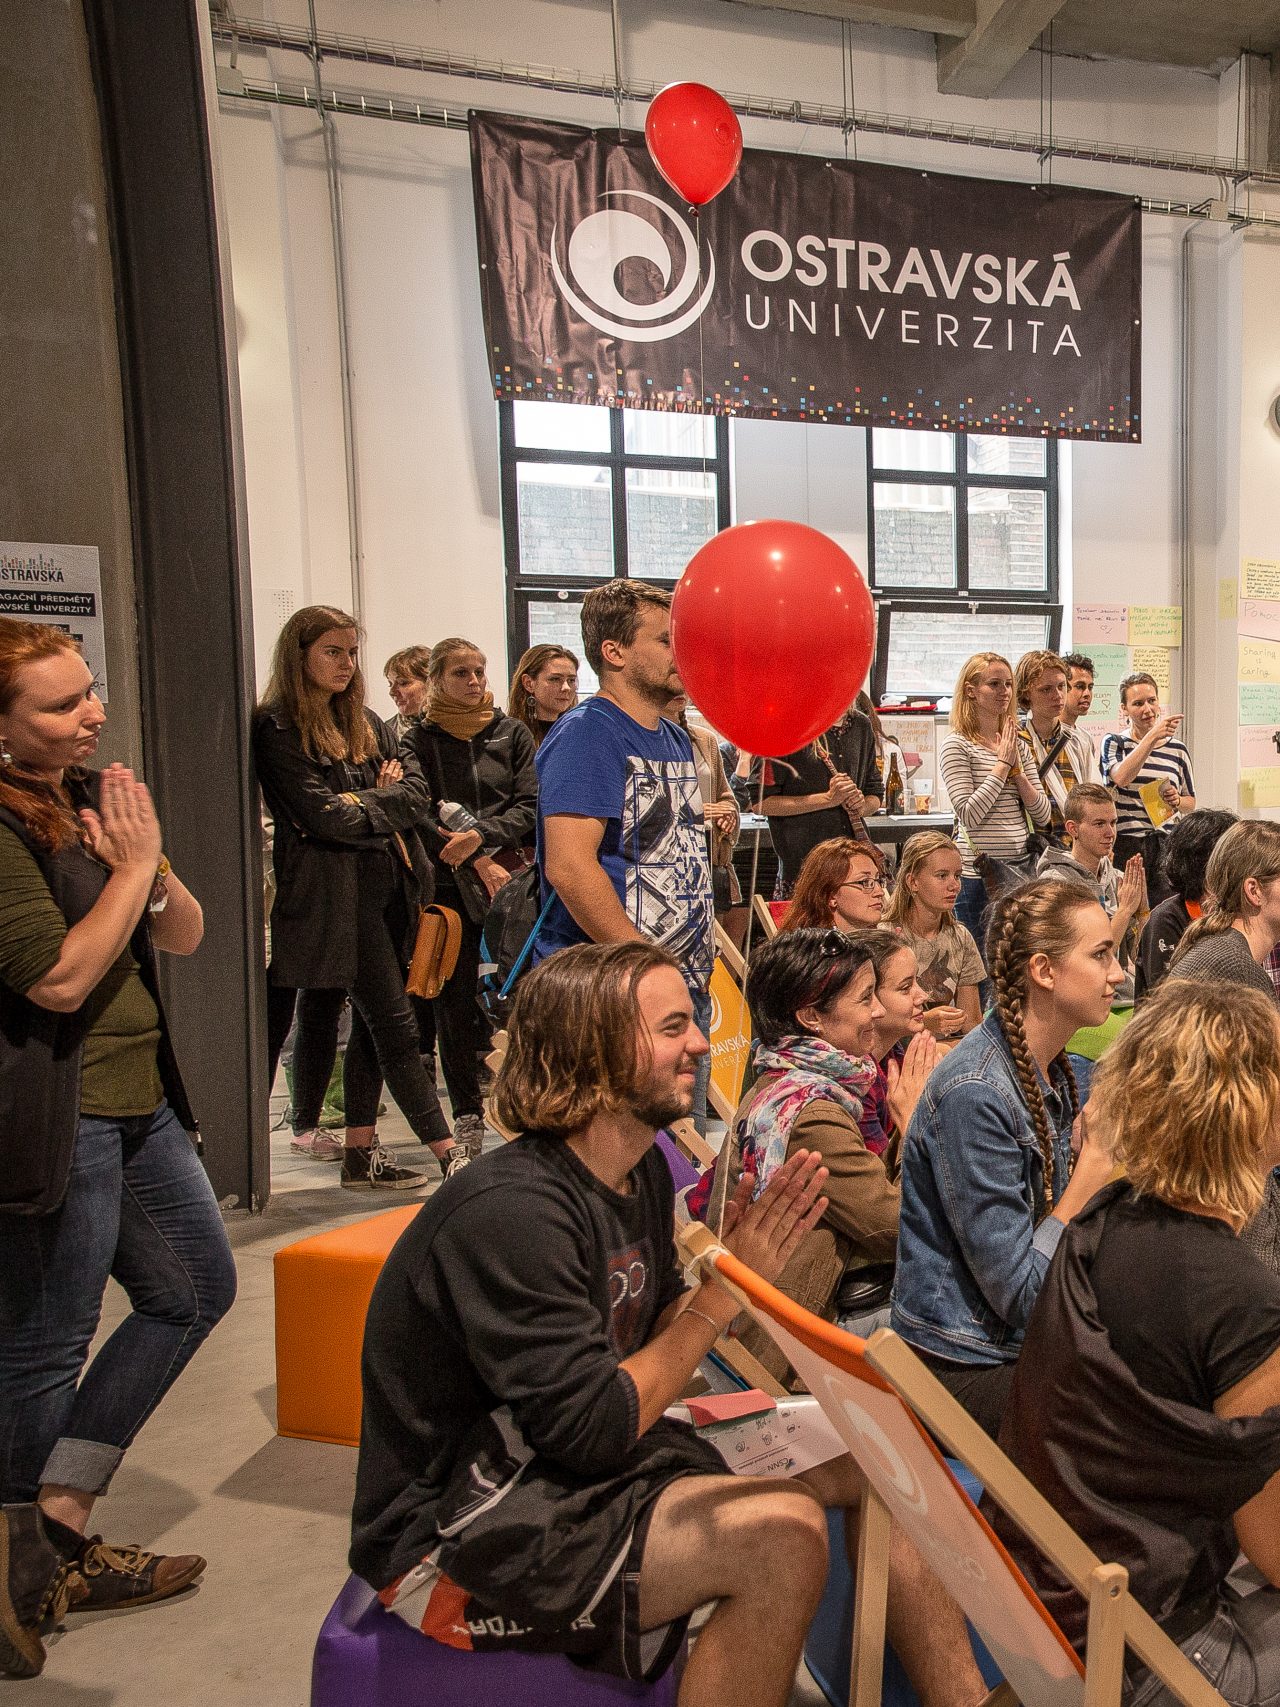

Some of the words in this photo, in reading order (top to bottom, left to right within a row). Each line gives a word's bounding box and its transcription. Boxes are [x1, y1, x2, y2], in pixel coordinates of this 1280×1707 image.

[741, 230, 1081, 311] OSTRAVSKÁ
[746, 294, 1081, 357] UNIVERZITA
[0, 568, 64, 582] STRAVSKÁ
[34, 604, 92, 613] UNIVERZITY
[40, 593, 92, 604] PŘEDMĚTY
[709, 1031, 749, 1058] RAVSKÁ
